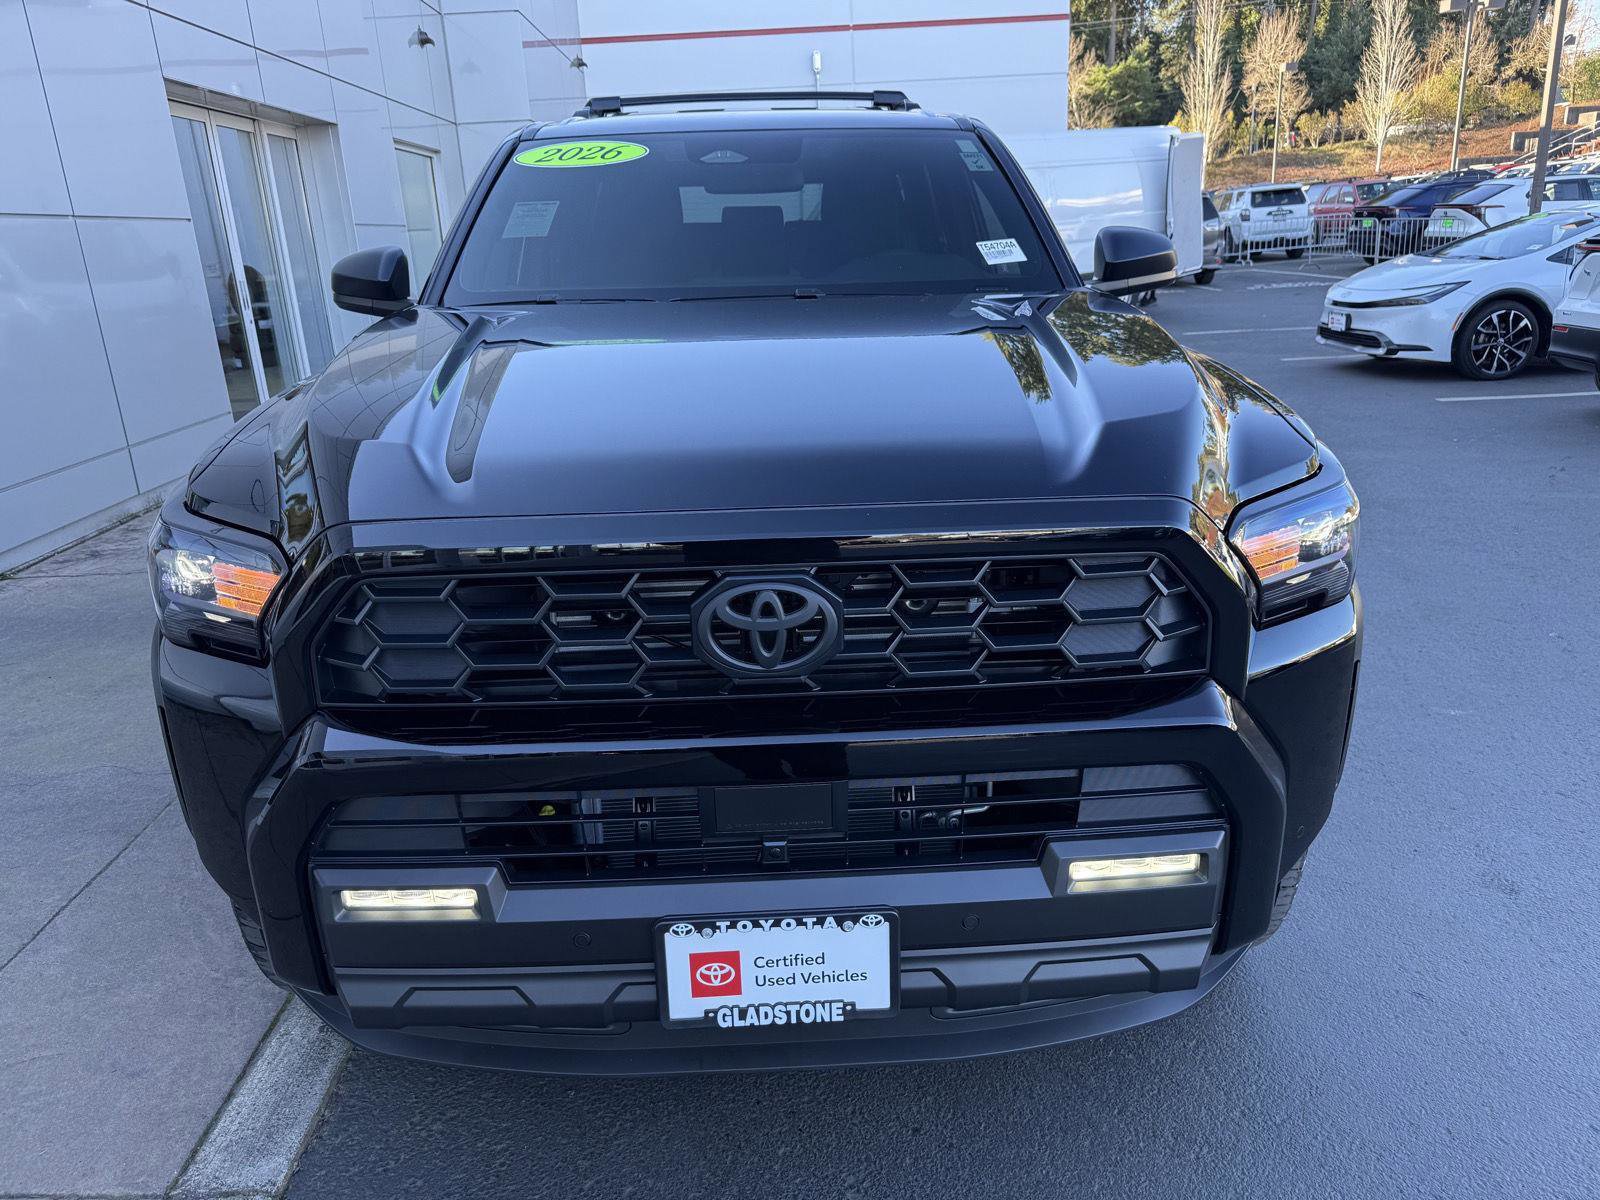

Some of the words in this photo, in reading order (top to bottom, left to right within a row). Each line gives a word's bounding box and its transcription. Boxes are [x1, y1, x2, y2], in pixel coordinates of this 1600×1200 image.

[534, 145, 631, 163] 2026
[978, 241, 1017, 251] T54704A
[715, 916, 838, 933] TOYOTA
[753, 952, 826, 969] Certified
[754, 972, 796, 987] Used
[800, 969, 868, 985] Vehicles
[716, 1001, 845, 1028] GLADSTONE
